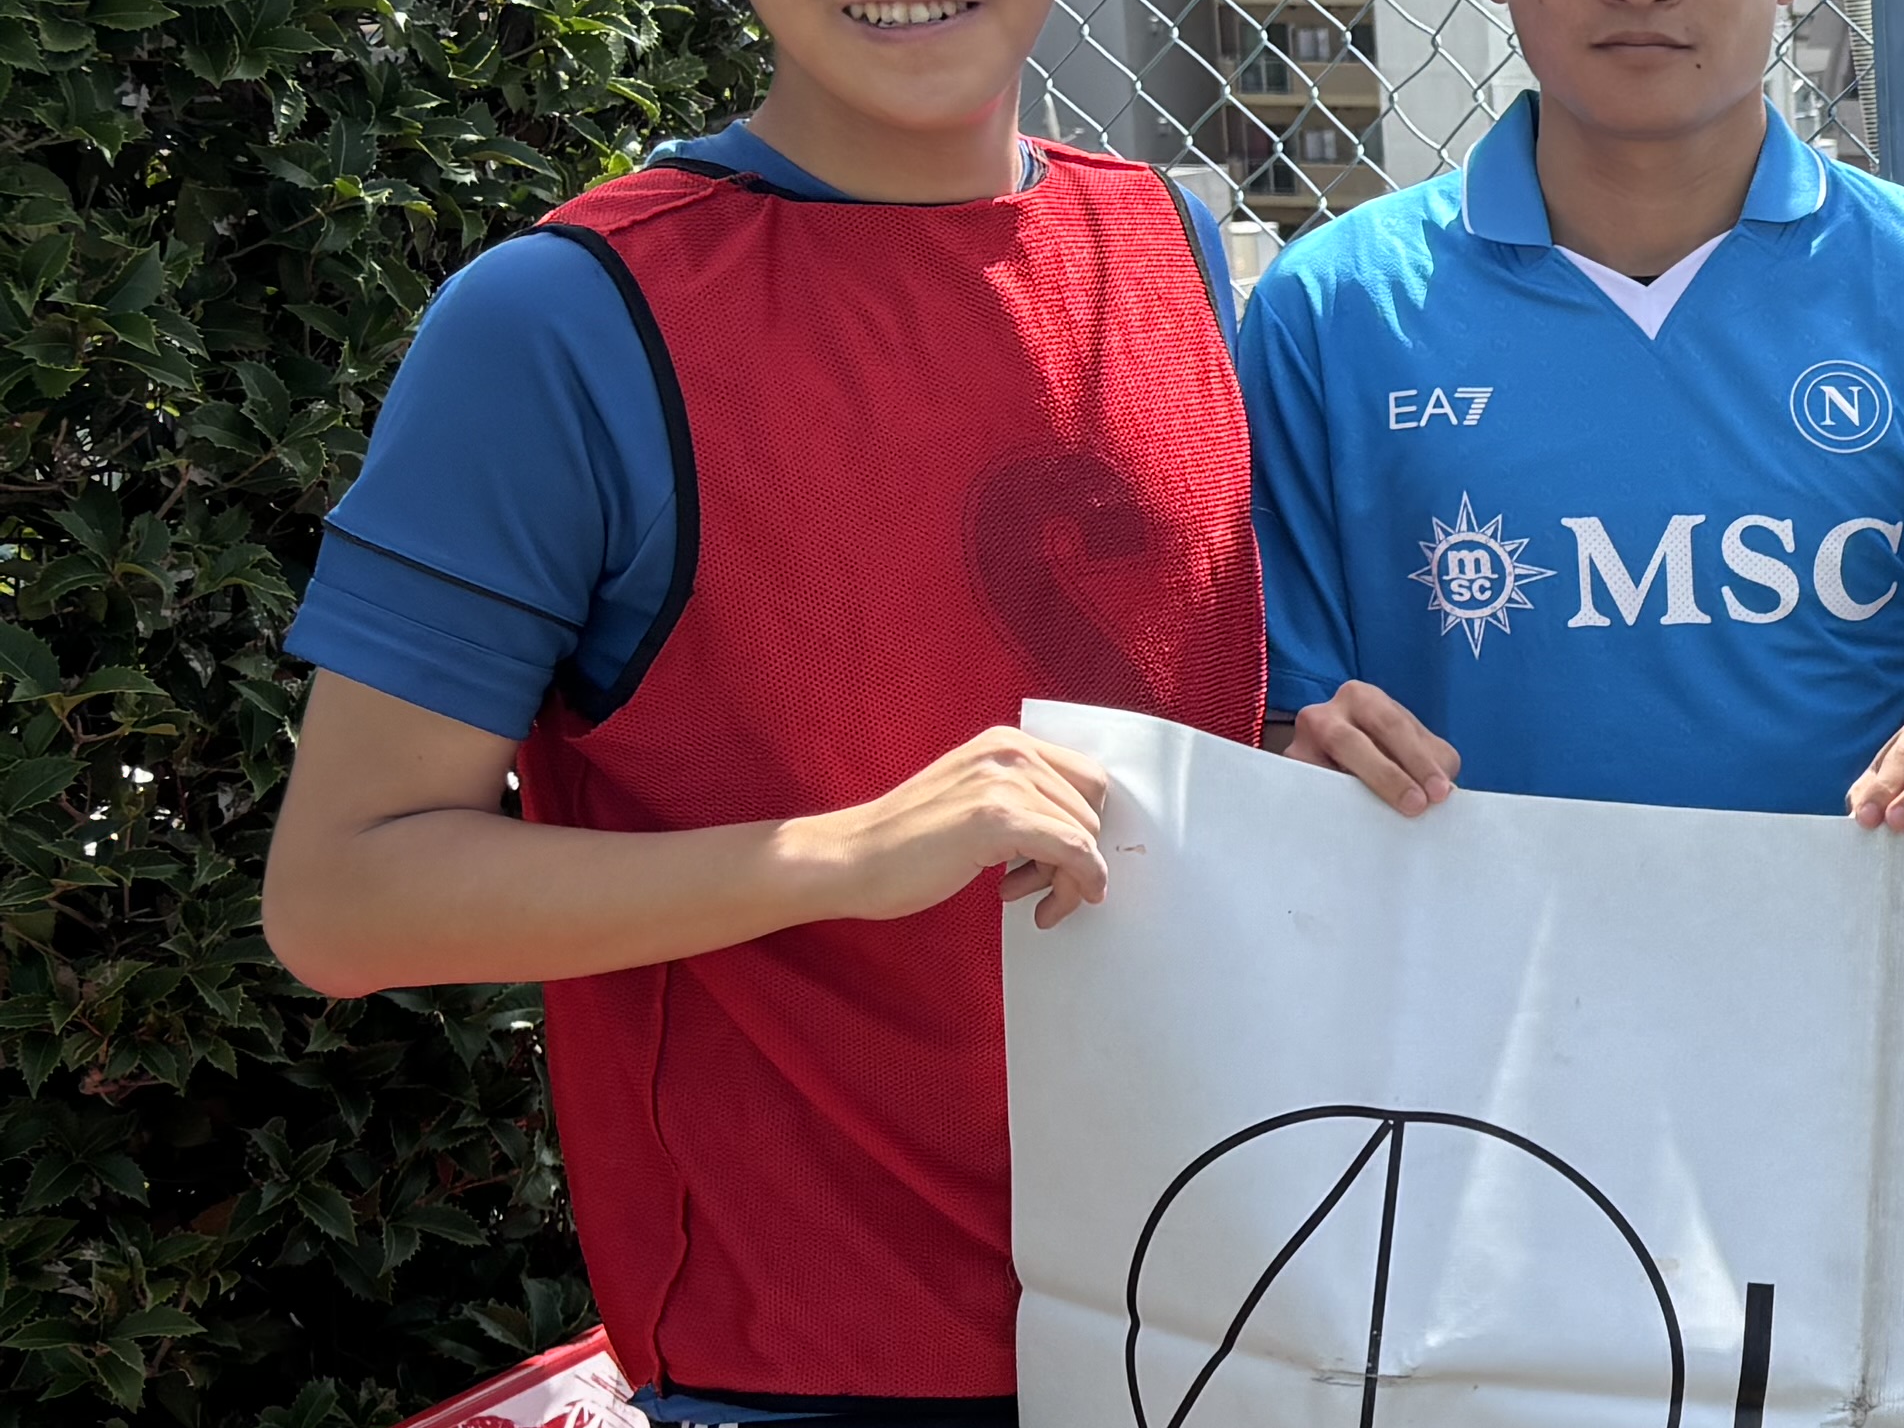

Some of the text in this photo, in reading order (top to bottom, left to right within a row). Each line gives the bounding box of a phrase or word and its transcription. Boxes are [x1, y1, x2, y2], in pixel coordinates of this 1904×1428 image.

[1389, 386, 1493, 429] EA7
[1820, 385, 1862, 427] N
[1561, 514, 1903, 628] MSC
